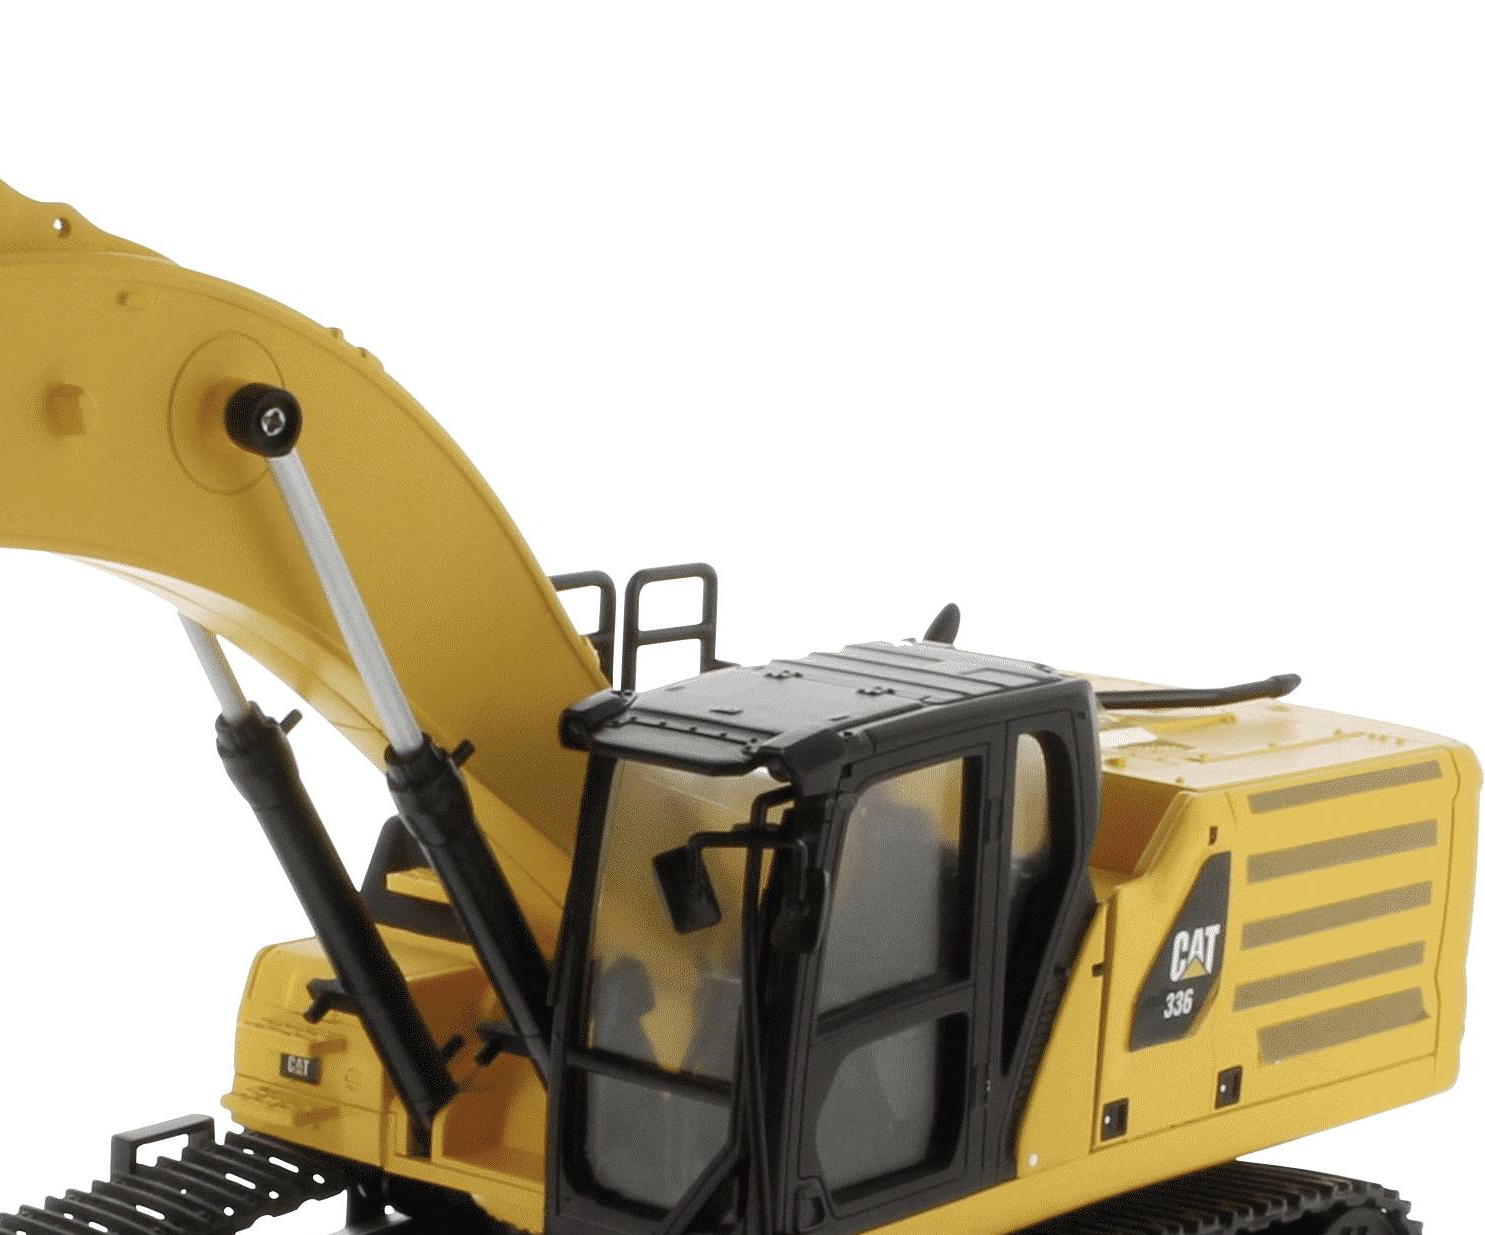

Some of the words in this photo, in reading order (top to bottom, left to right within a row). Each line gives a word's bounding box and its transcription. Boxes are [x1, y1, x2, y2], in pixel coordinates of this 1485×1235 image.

[1170, 923, 1221, 982] CAT
[1163, 988, 1194, 1019] 336
[287, 1055, 310, 1077] CAT
